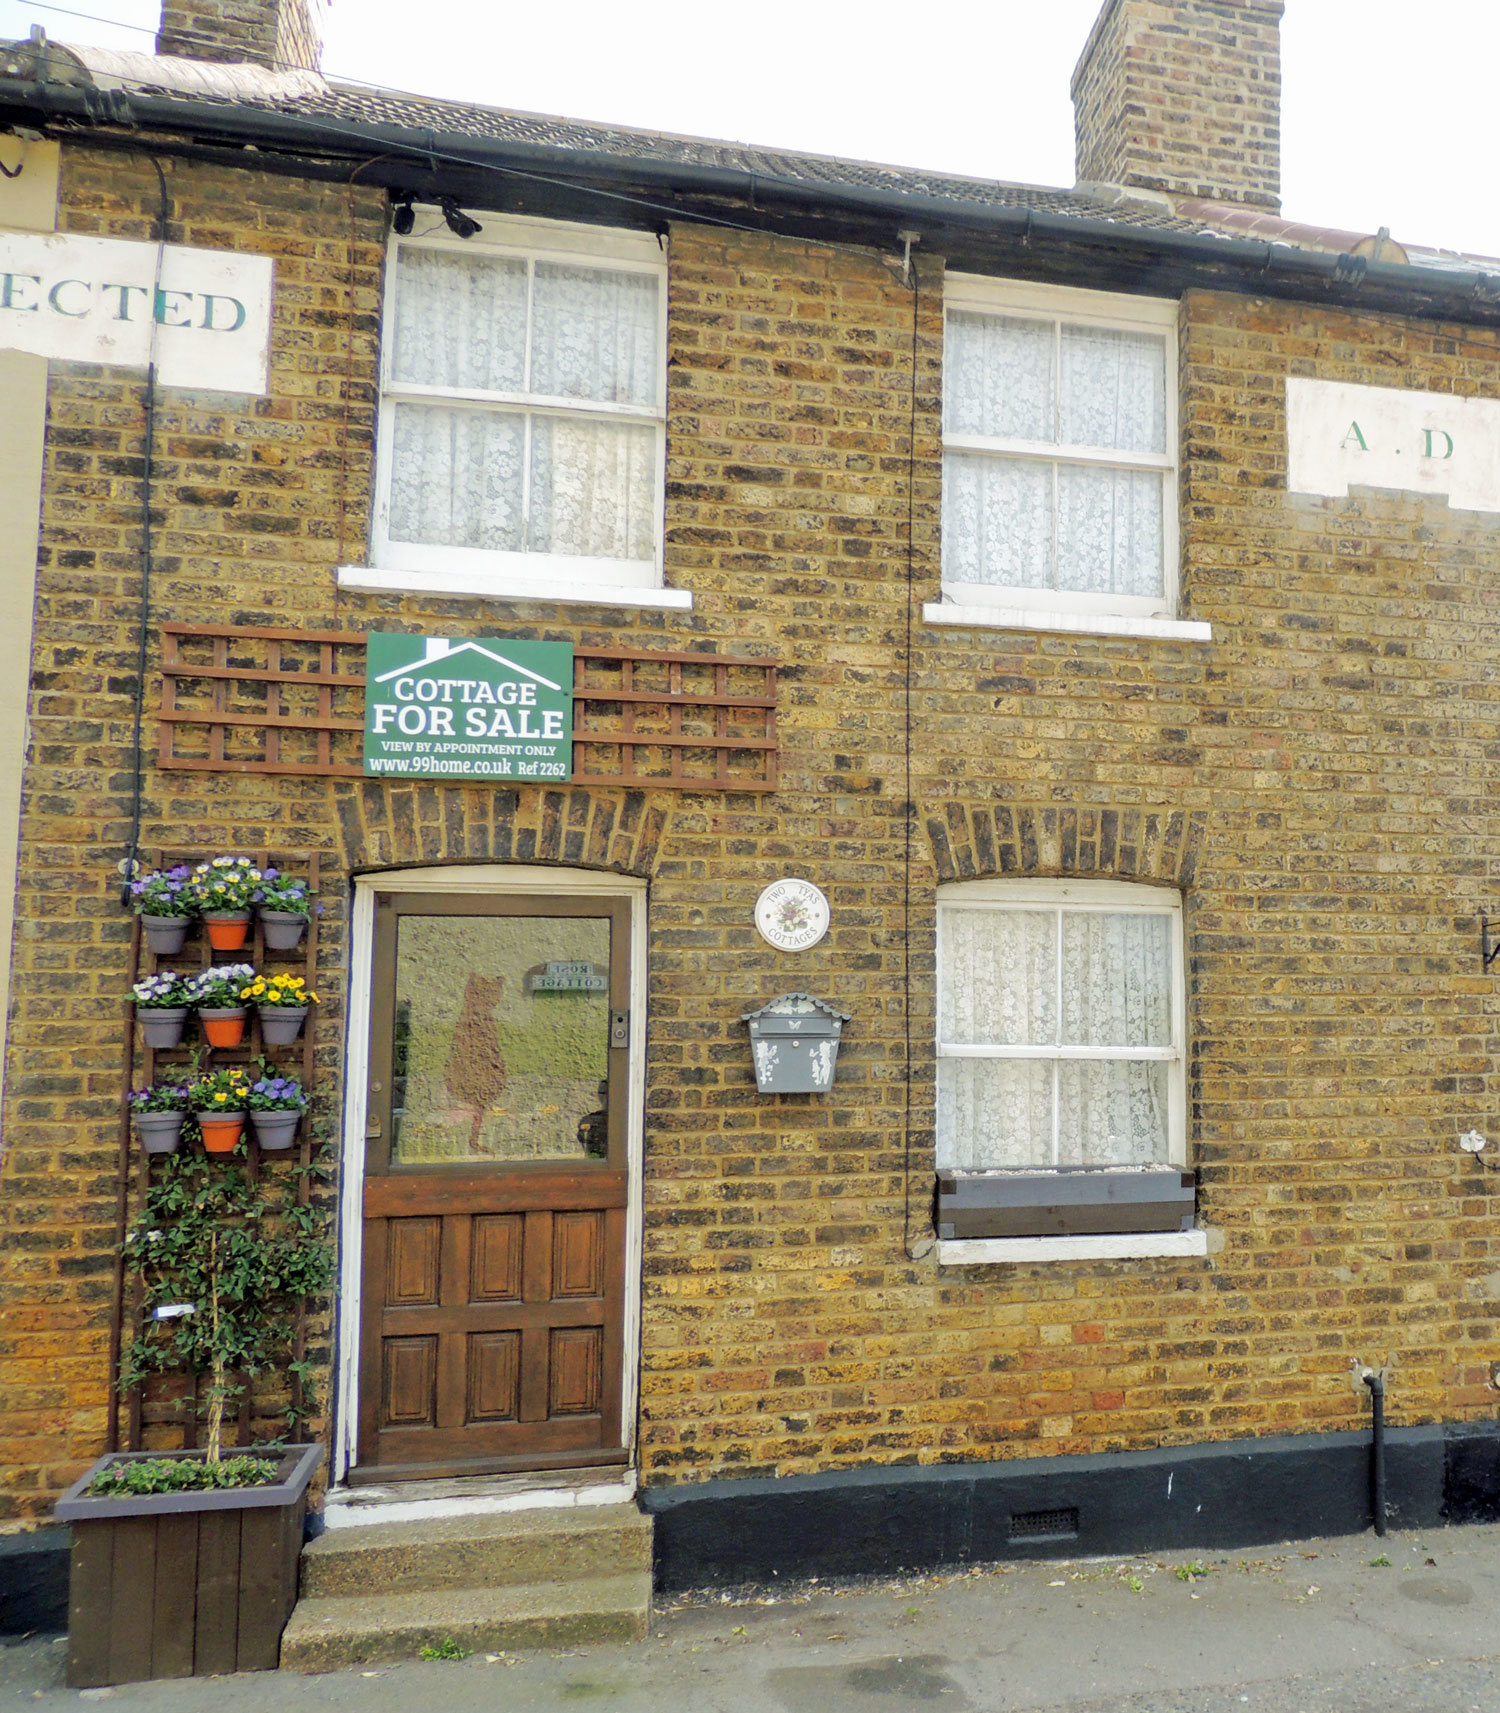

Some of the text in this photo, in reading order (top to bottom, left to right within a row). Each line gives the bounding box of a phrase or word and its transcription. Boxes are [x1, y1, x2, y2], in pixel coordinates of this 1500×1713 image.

[394, 678, 537, 706] COTTAGE
[372, 703, 564, 739] FOR SALE
[381, 741, 556, 756] VIEW BY APPOINTMENT ONLY
[369, 756, 566, 776] www.99home.co.uk Ref 2262
[767, 886, 819, 904] TWO TYAS
[768, 926, 817, 945] COTTAGES
